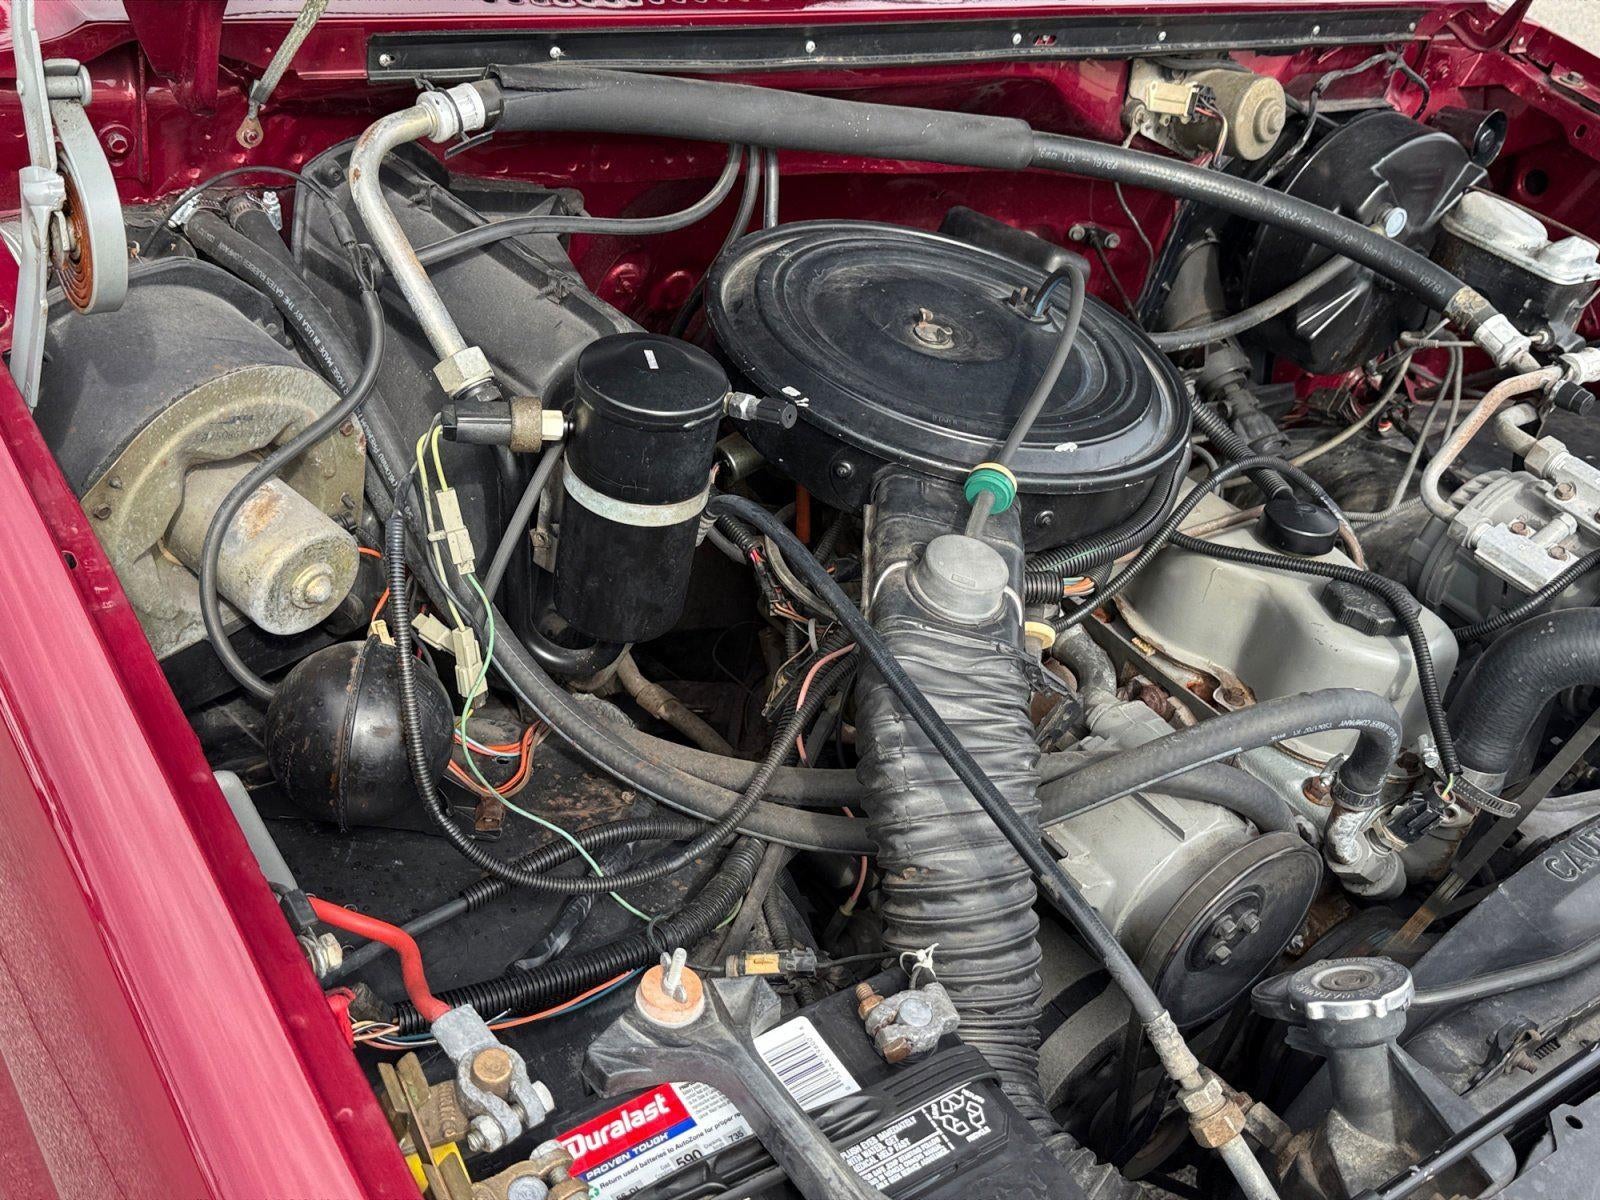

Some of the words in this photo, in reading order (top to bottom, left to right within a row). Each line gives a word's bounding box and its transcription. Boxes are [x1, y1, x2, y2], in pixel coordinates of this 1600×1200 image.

[240, 257, 267, 281] RUBBER
[263, 276, 285, 298] GATES
[281, 295, 295, 311] THE
[292, 309, 303, 321] BY
[311, 335, 321, 346] IN
[317, 344, 334, 367] MADE
[330, 365, 346, 388] HOSE
[561, 1093, 670, 1159] Duralast
[727, 1129, 744, 1142] 735
[839, 1144, 862, 1160] FLUSH
[859, 1135, 878, 1150] EYES
[876, 1115, 917, 1141] IMMEDIATELY
[876, 1145, 895, 1160] HELP
[893, 1137, 911, 1151] FAST
[883, 1134, 899, 1146] GET
[585, 1151, 631, 1180] PROVEN
[631, 1131, 669, 1155] TOUGH
[599, 1173, 622, 1189] Return
[621, 1164, 639, 1177] used
[638, 1149, 667, 1168] batteries
[674, 1130, 704, 1149] AutoZone
[703, 1125, 713, 1133] for
[713, 1115, 734, 1129] proper
[675, 1147, 703, 1167] 590
